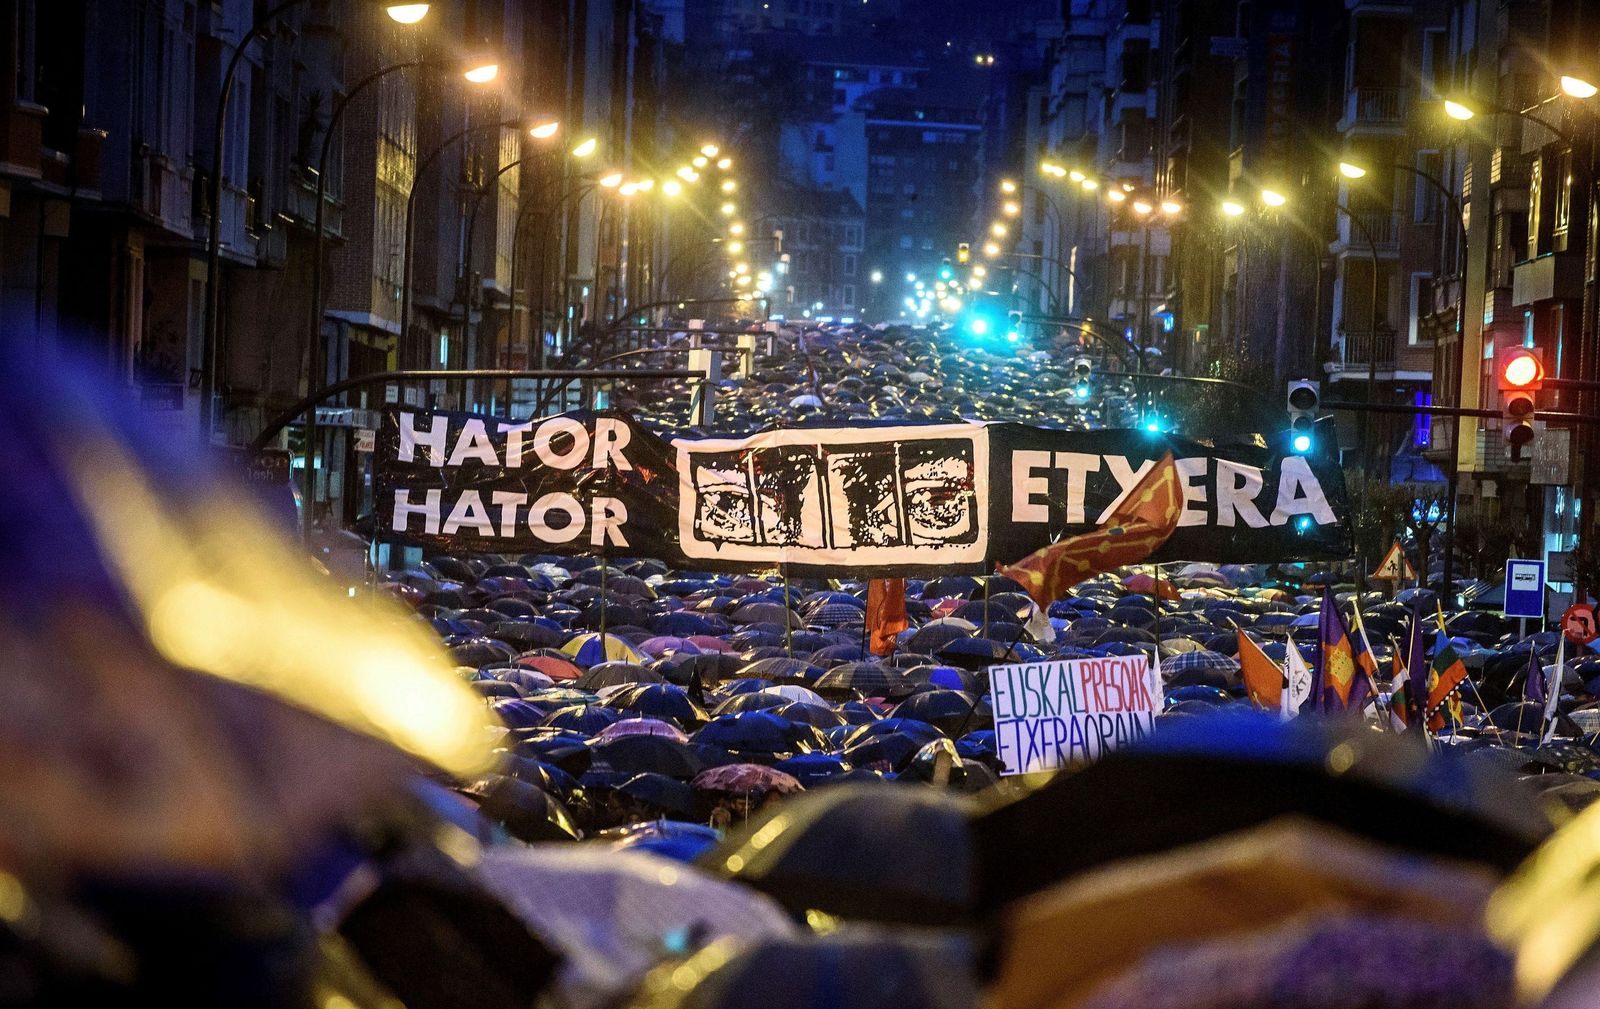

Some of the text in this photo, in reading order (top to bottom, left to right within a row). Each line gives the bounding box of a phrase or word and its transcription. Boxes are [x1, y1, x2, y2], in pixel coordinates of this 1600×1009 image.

[398, 412, 633, 471] HATOR
[392, 488, 630, 548] HATOR
[1011, 449, 1338, 528] ETXERA
[991, 656, 1153, 719] EUSKAL PRESOAK
[996, 715, 1089, 774] ETXERA
